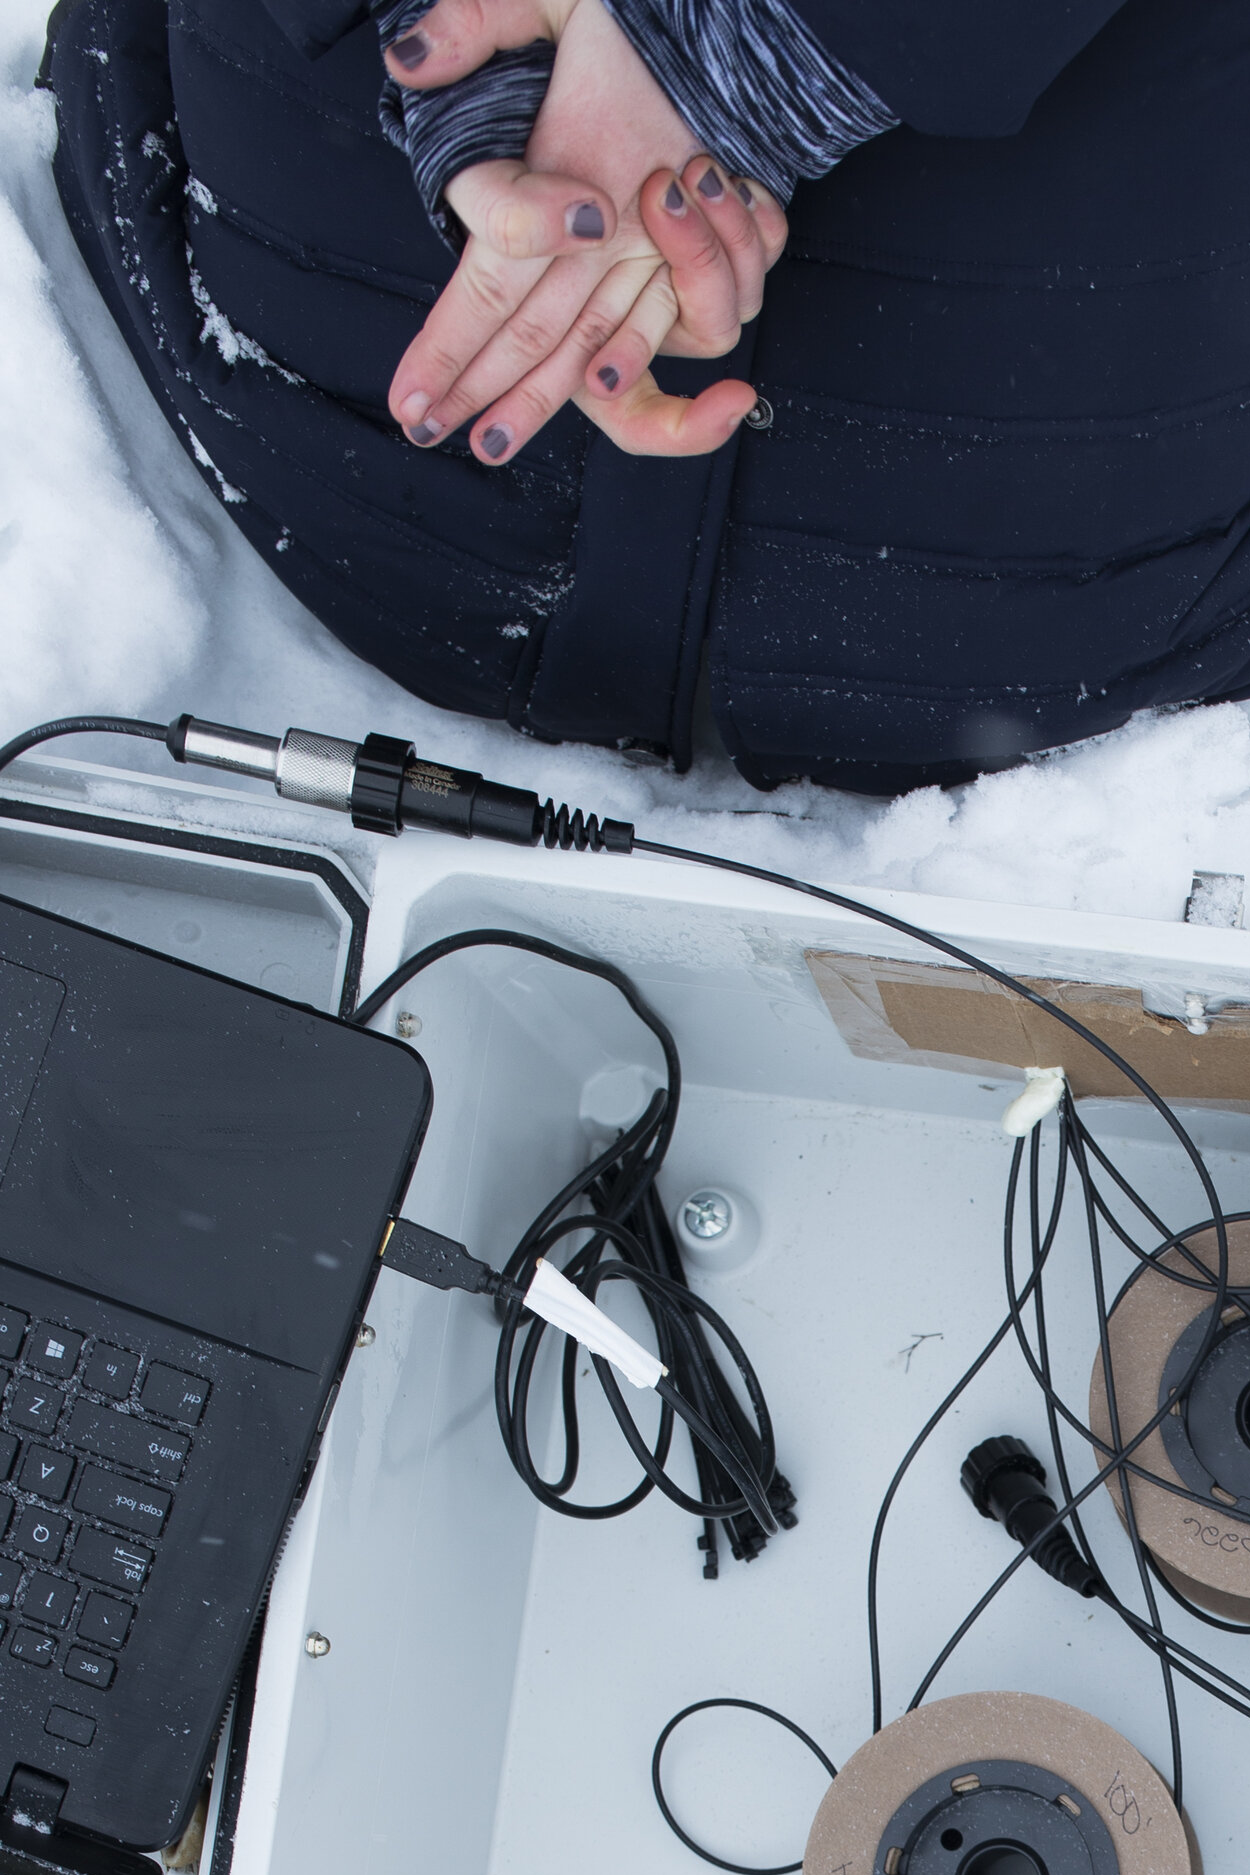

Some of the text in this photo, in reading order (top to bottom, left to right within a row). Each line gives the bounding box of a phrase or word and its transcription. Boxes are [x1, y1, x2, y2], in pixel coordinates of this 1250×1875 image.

[410, 779, 449, 798] 308444
[106, 1363, 118, 1376] fn
[29, 1396, 45, 1415] Z
[183, 1392, 202, 1406] ctrl
[159, 1446, 183, 1463] shift
[41, 1463, 55, 1479] A
[115, 1494, 163, 1518] caps lock
[33, 1524, 50, 1543] Q
[124, 1568, 142, 1582] tab
[45, 1591, 55, 1608] 1
[80, 1660, 99, 1675] esc
